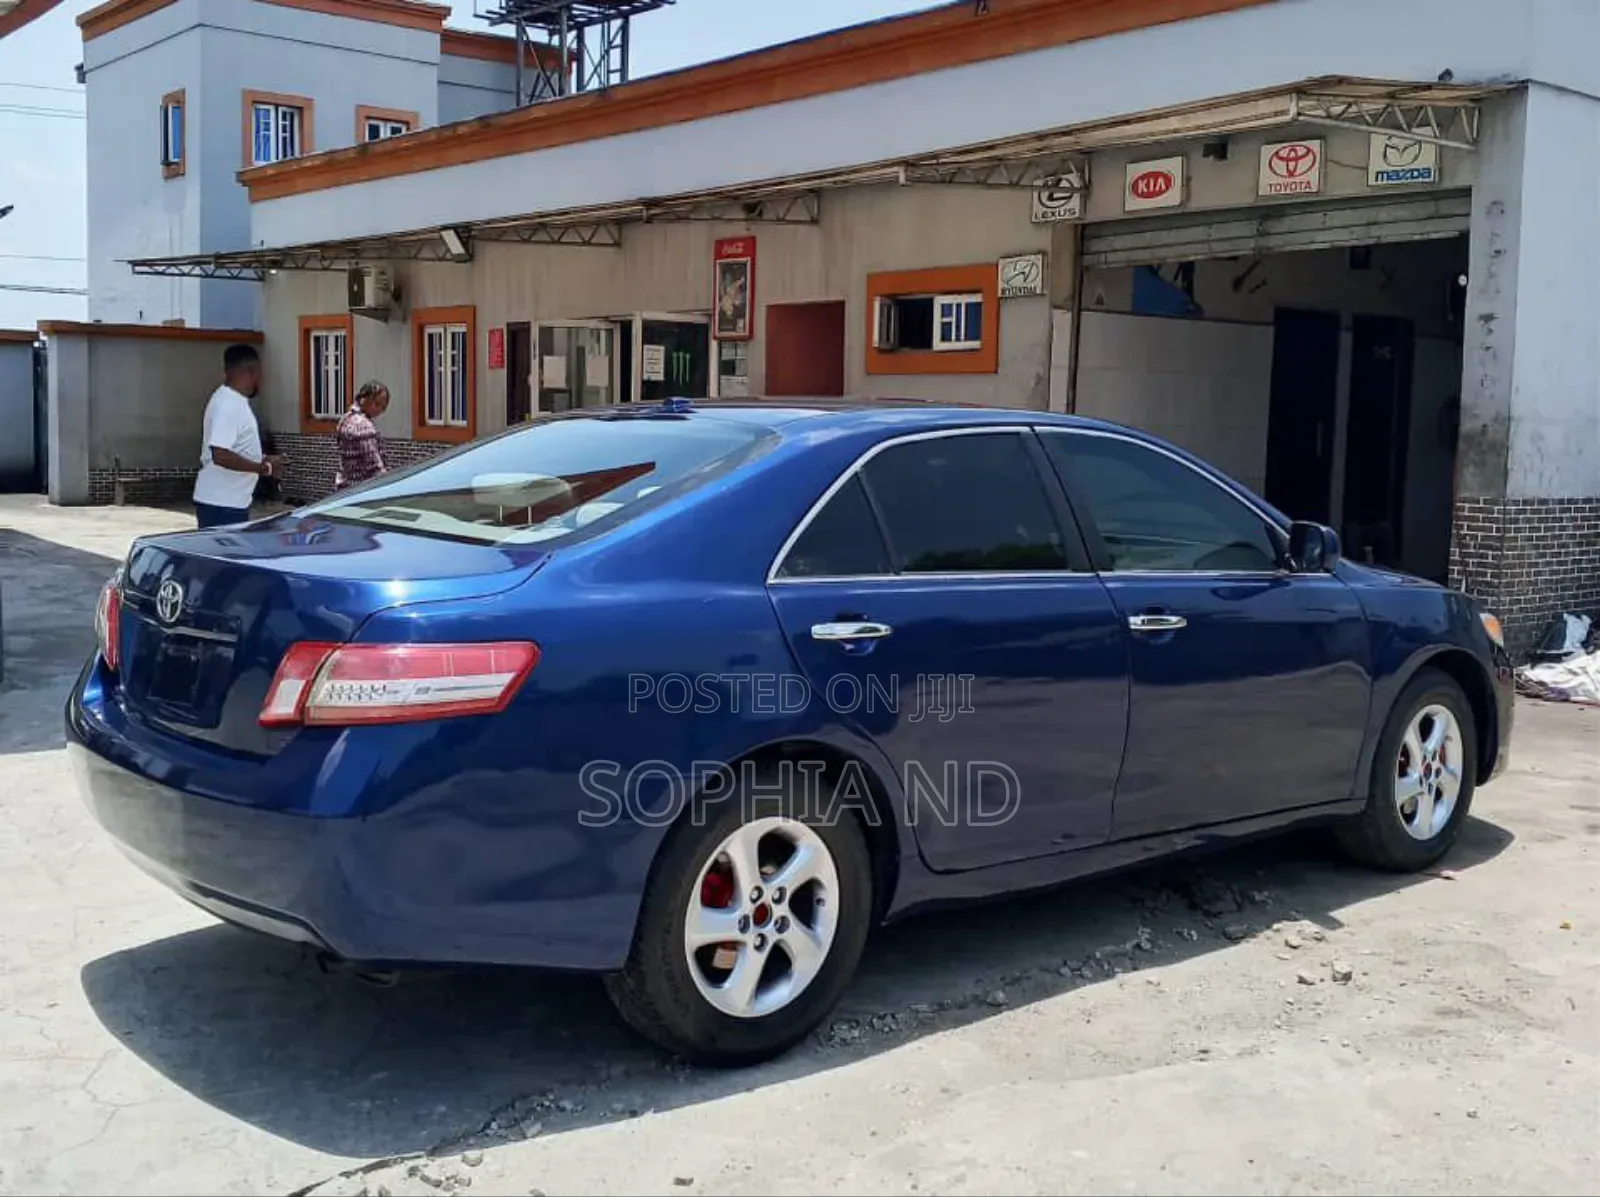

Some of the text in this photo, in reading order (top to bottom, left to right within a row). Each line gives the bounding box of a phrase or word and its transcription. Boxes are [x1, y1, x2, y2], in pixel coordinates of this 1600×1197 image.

[1137, 176, 1167, 194] KIA
[1267, 180, 1312, 193] TOYOTA
[1033, 207, 1077, 220] LEXUS
